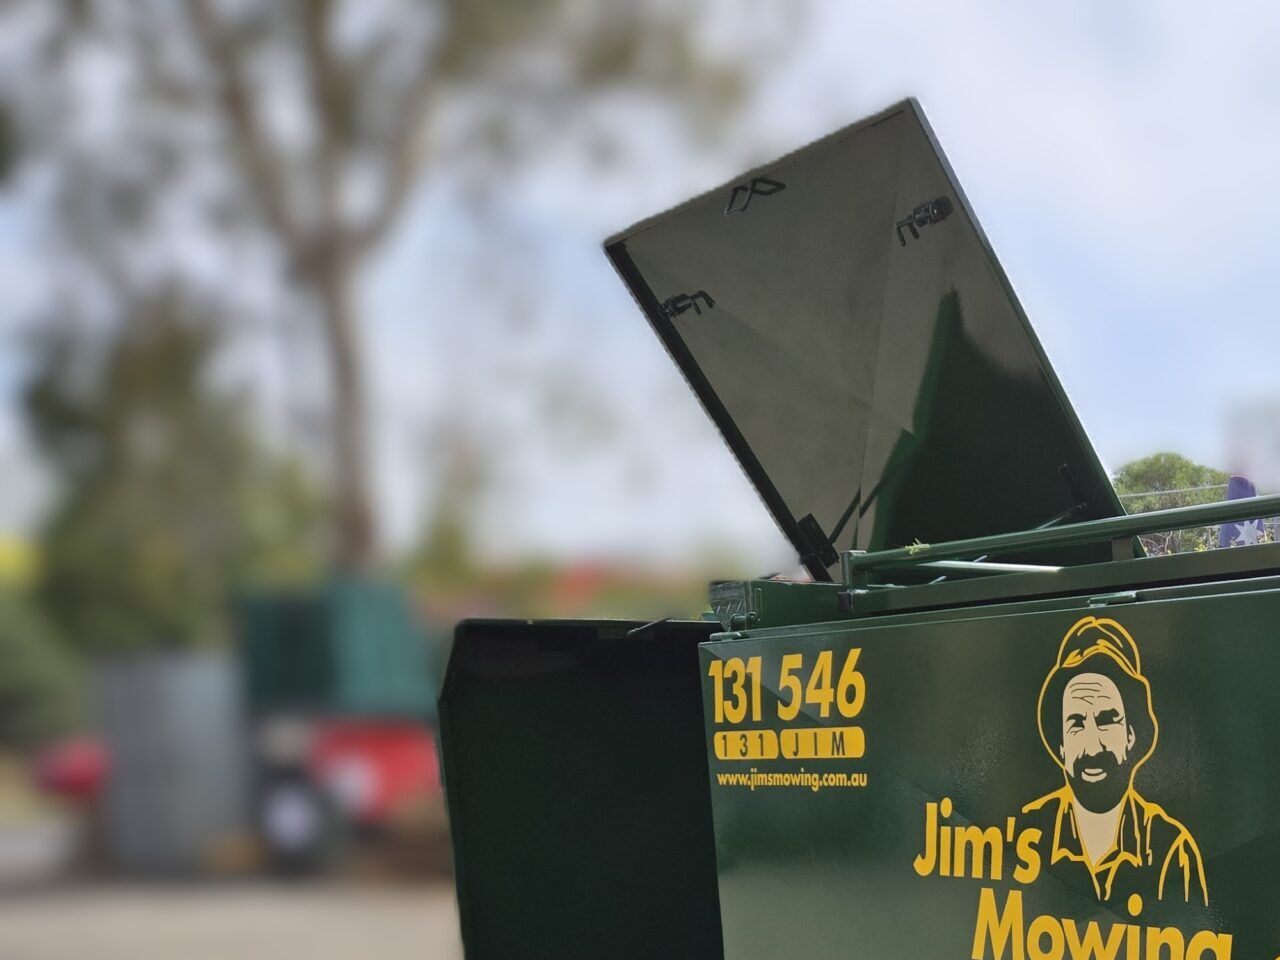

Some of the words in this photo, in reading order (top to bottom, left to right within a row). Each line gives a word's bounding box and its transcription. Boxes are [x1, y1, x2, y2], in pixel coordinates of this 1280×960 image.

[708, 656, 763, 724] 131
[777, 647, 866, 721] 546
[721, 732, 765, 758] 131
[792, 730, 847, 757] JIM
[717, 767, 868, 792] www.jimsmowing.com.au
[913, 797, 1042, 884] Jim's
